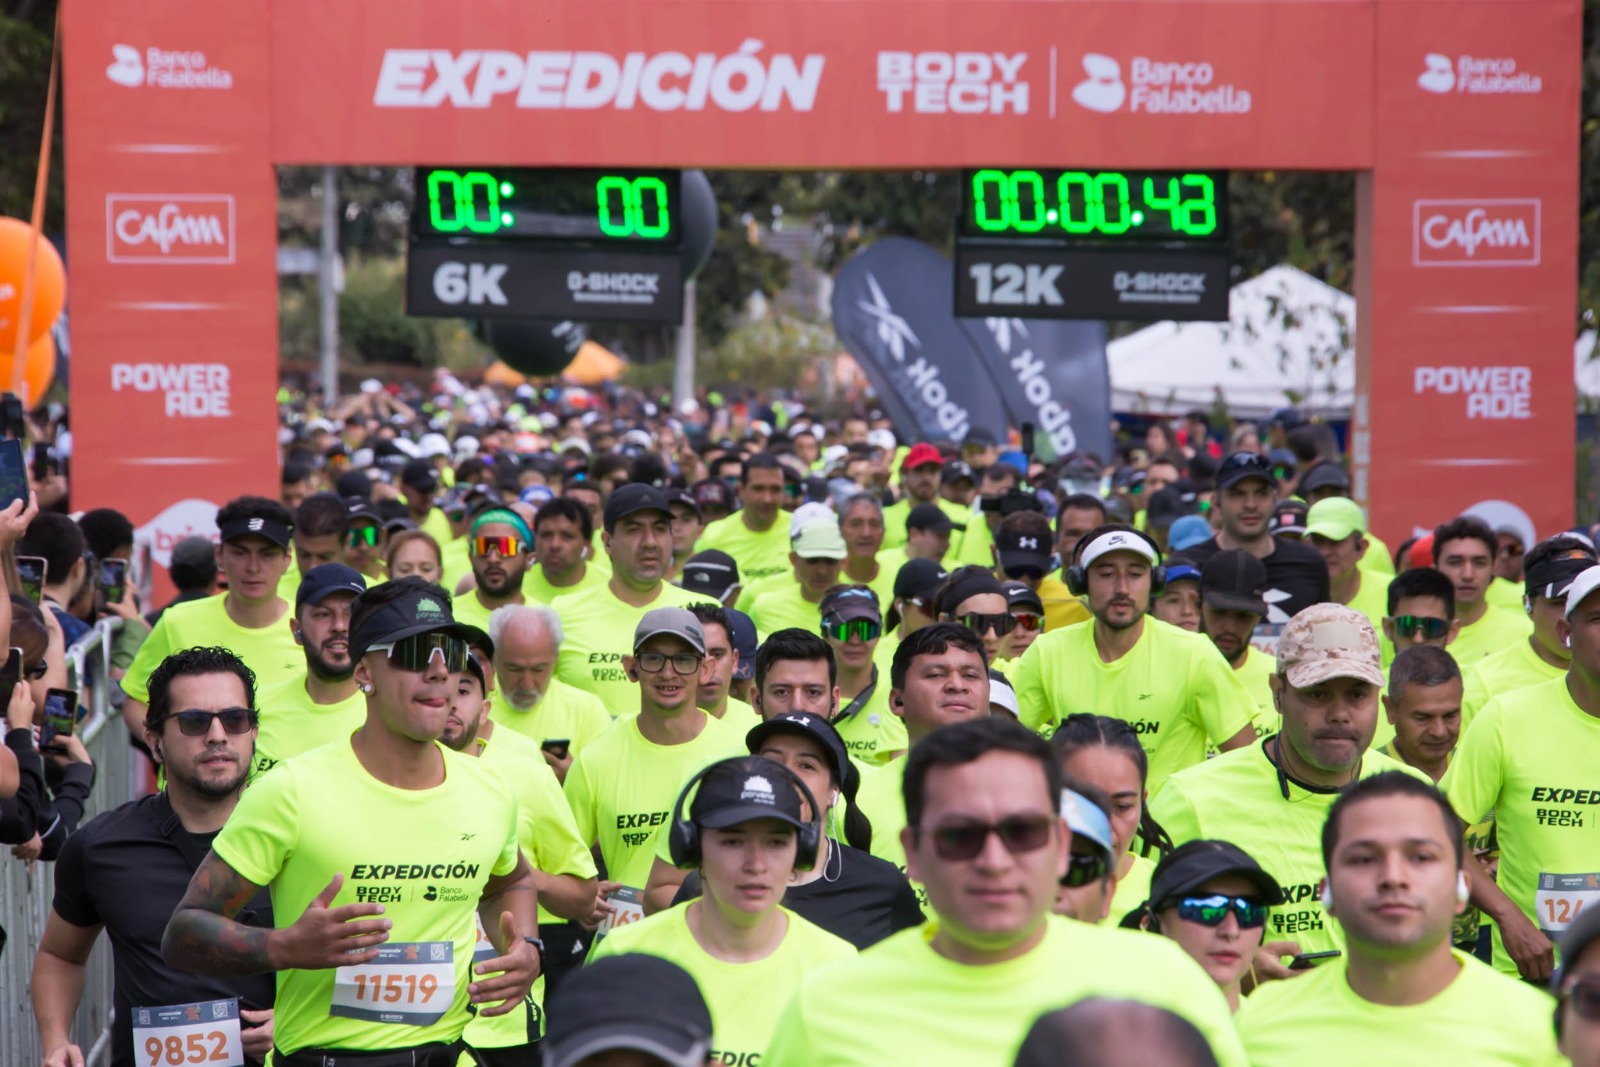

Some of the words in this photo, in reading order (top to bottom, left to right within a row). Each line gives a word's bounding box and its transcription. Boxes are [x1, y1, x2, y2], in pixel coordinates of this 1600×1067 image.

[147, 48, 206, 67] Banco
[877, 51, 1028, 83] BODY
[1131, 57, 1214, 85] Banco
[1458, 55, 1516, 74] Banco
[147, 67, 233, 88] Falabella
[374, 38, 825, 112] EXPEDICIÓN
[1458, 73, 1542, 93] Falabella
[877, 82, 1029, 114] TECH
[1131, 85, 1251, 114] Falabella
[597, 176, 670, 238] 00
[433, 261, 509, 305] 6K
[969, 263, 1064, 306] 12K
[111, 363, 230, 391] POWER
[1414, 366, 1531, 394] POWER
[165, 391, 230, 418] ADE
[1467, 392, 1531, 419] ADE
[1536, 808, 1582, 818] BODY
[1537, 817, 1583, 827] TECH
[350, 860, 480, 880] EXPEDICIÓN
[356, 886, 402, 895] BODY
[356, 894, 401, 903] TECH
[439, 894, 469, 902] Falabella
[440, 886, 462, 894] Banco
[1273, 910, 1322, 924] BODY
[1273, 920, 1323, 933] TECH
[354, 974, 438, 1004] 11519
[145, 1031, 229, 1067] 9852
